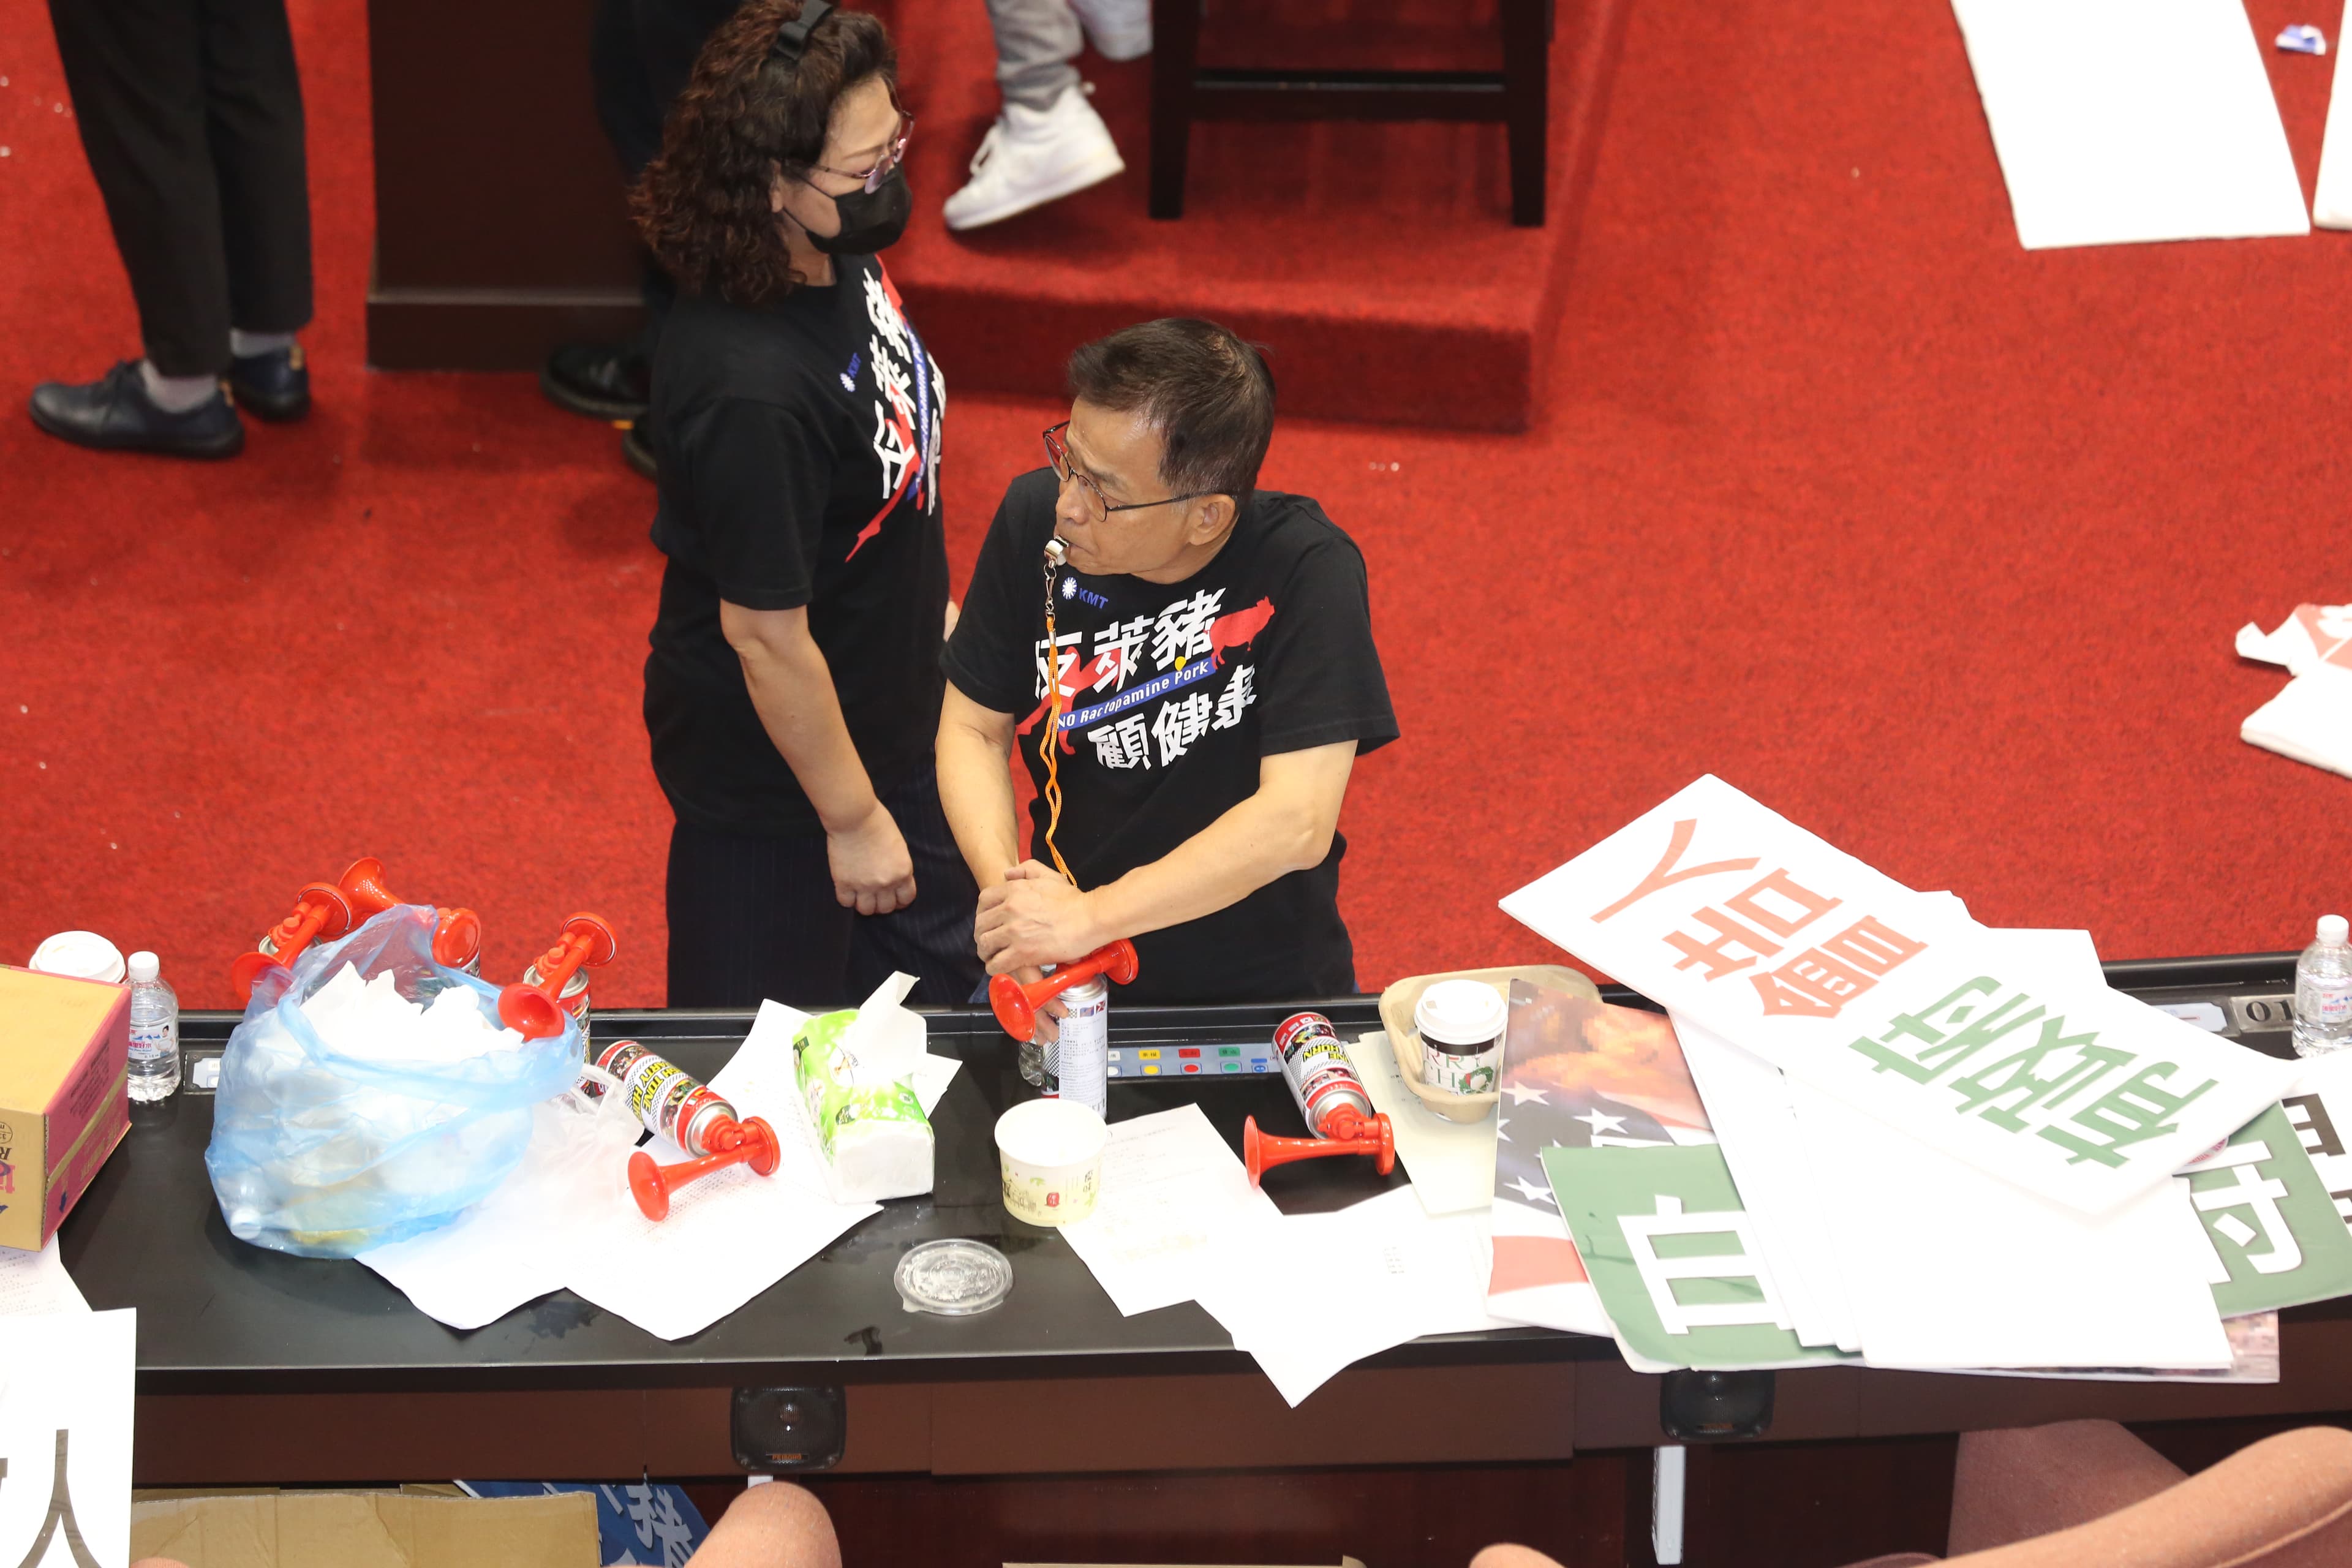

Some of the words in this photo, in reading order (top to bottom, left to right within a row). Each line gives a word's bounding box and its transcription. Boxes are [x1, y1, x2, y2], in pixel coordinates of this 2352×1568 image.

[1079, 588, 1109, 609] KMT
[1035, 587, 1226, 700] 反萊豬
[1080, 678, 1170, 723] Ractopamine
[1174, 661, 1210, 685] Pork
[1589, 818, 1929, 1019] 會告人
[639, 1060, 671, 1087] ARTY
[1302, 1043, 1340, 1063] HORN
[1849, 975, 2219, 1169] 有政府
[642, 1075, 665, 1115] TONE
